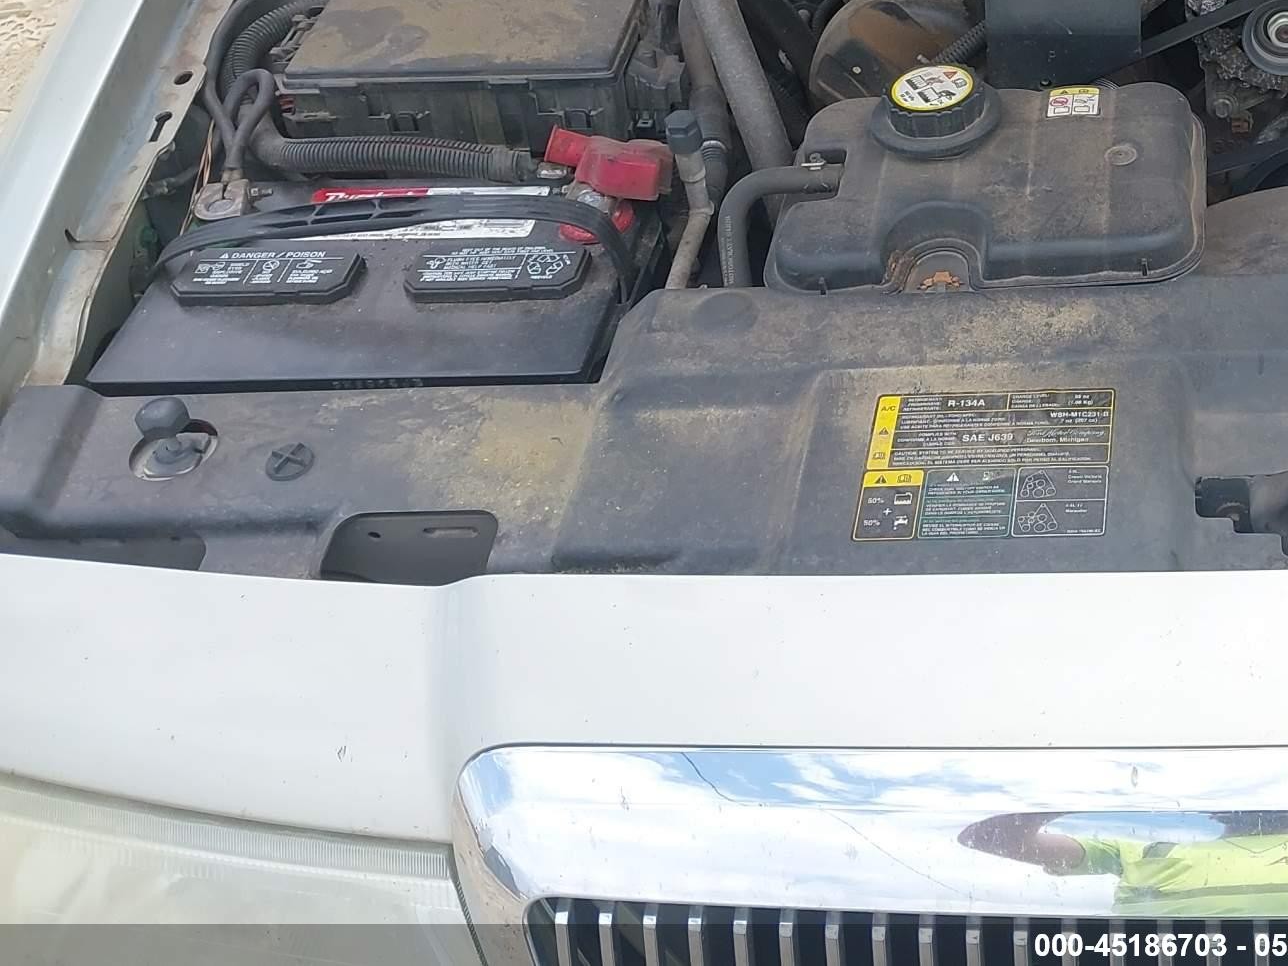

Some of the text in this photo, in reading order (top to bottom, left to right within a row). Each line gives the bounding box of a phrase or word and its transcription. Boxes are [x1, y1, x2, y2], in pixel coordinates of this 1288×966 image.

[947, 398, 986, 408] R-134A
[962, 432, 1014, 442] SAE J639
